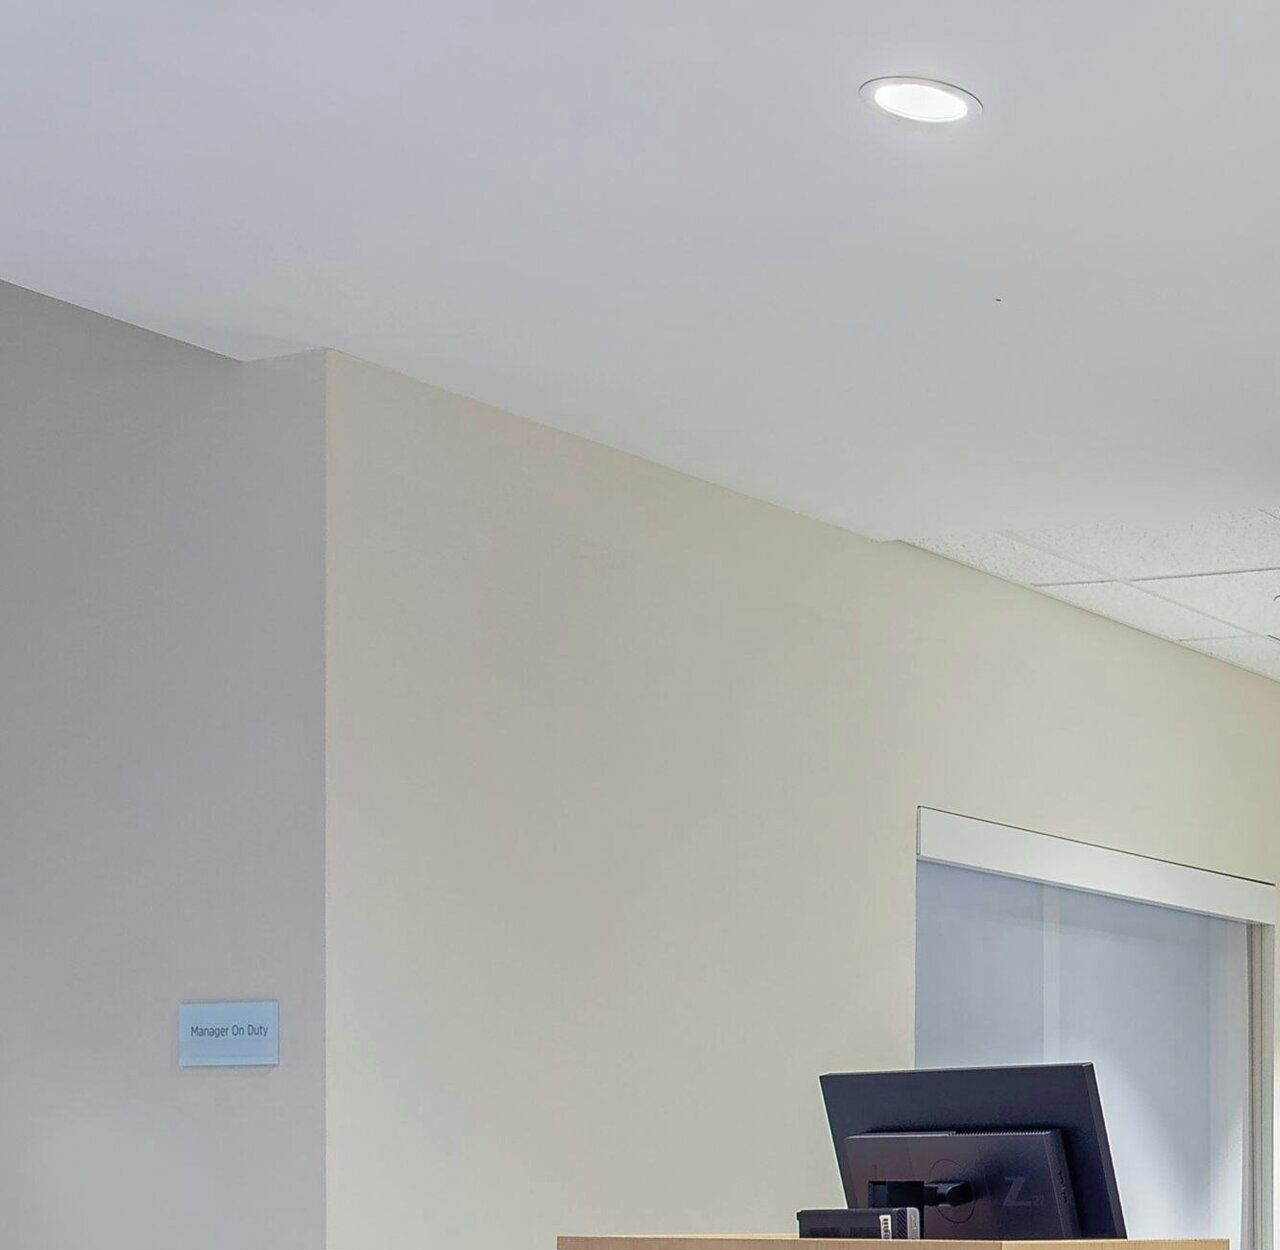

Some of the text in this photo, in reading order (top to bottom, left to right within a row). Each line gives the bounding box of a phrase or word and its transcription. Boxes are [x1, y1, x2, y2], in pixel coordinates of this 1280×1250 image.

[191, 1024, 268, 1038] Manager On Duty
